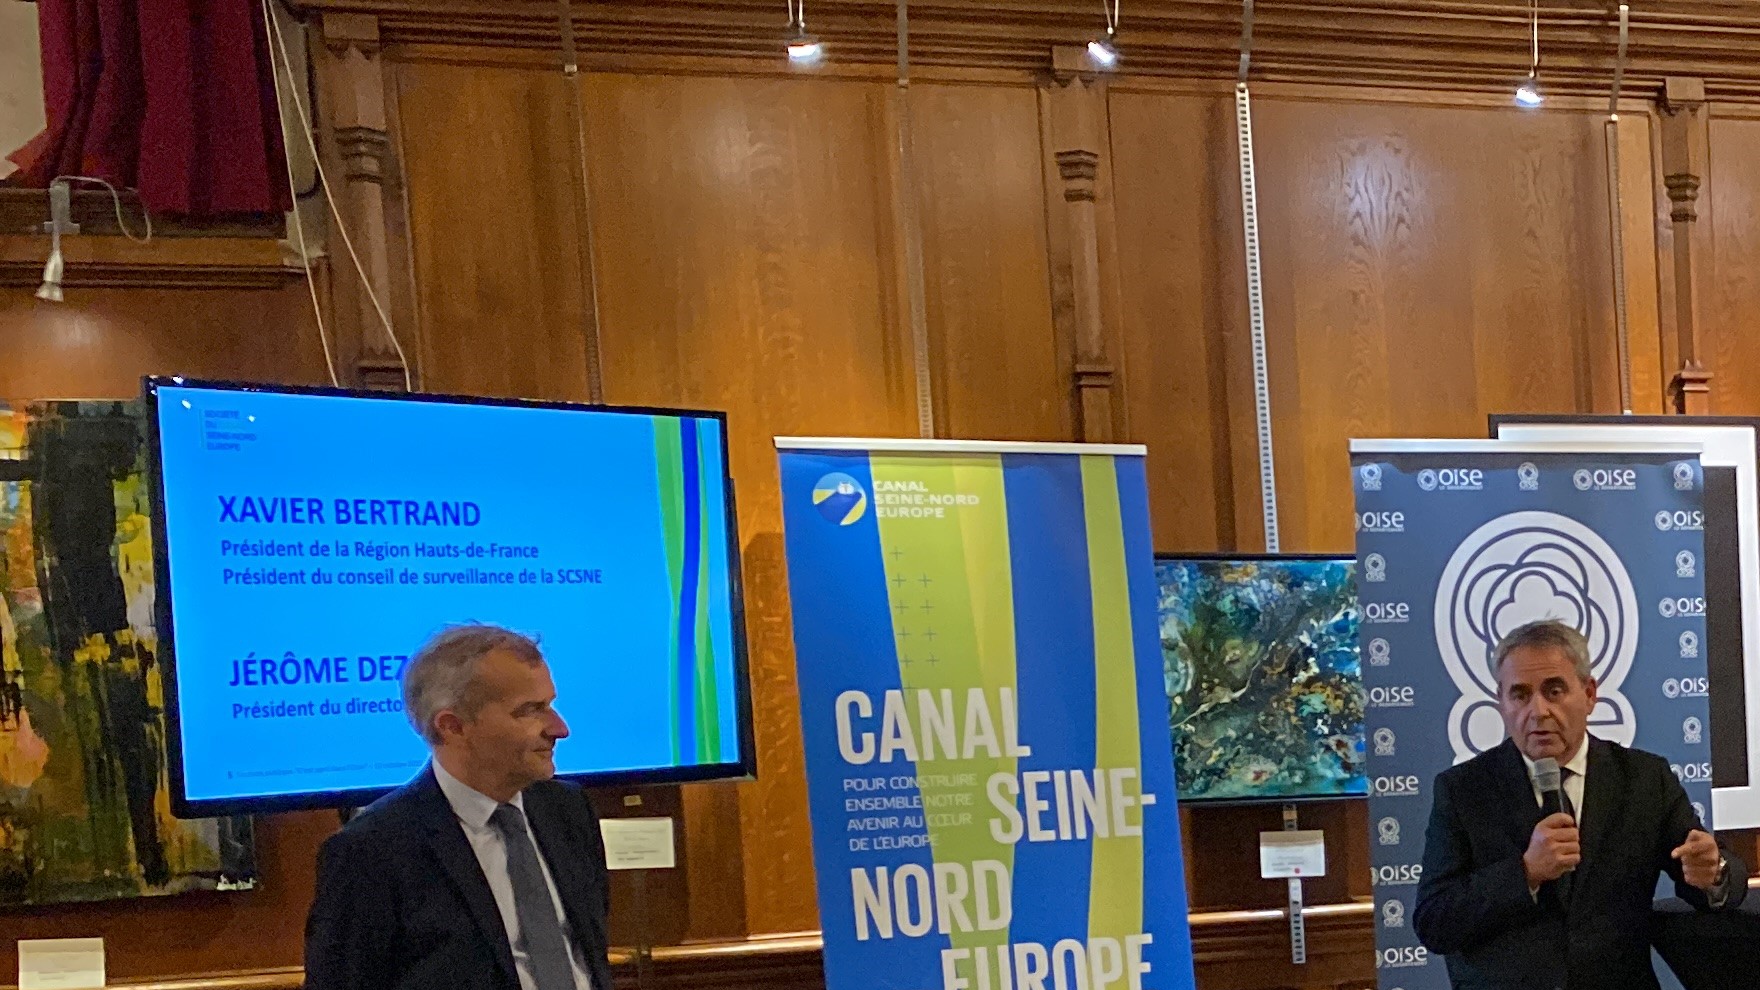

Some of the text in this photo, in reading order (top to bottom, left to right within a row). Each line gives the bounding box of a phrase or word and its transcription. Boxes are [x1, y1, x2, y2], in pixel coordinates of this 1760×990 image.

[874, 481, 928, 492] CANAL
[875, 494, 980, 505] SEINE-NORD
[218, 495, 481, 526] XAVIER BERTRAND
[877, 507, 945, 518] EUROPE
[221, 539, 539, 561] Président de la Région Hauts-de-France
[223, 567, 602, 585] Président du conseil de surveillance de la SCSNE
[229, 651, 407, 686] JÉRÔME DEZ
[232, 698, 402, 719] Président du directo
[835, 687, 1032, 765] CANAL
[843, 774, 978, 792] POUR CONSTRUIRE
[845, 793, 975, 812] ENSEMBLE NOTRE
[985, 767, 1156, 844] SEINE-
[847, 816, 900, 832] AVENIR
[903, 815, 923, 828] AU
[849, 838, 870, 852] DE
[851, 859, 1012, 941] NORD
